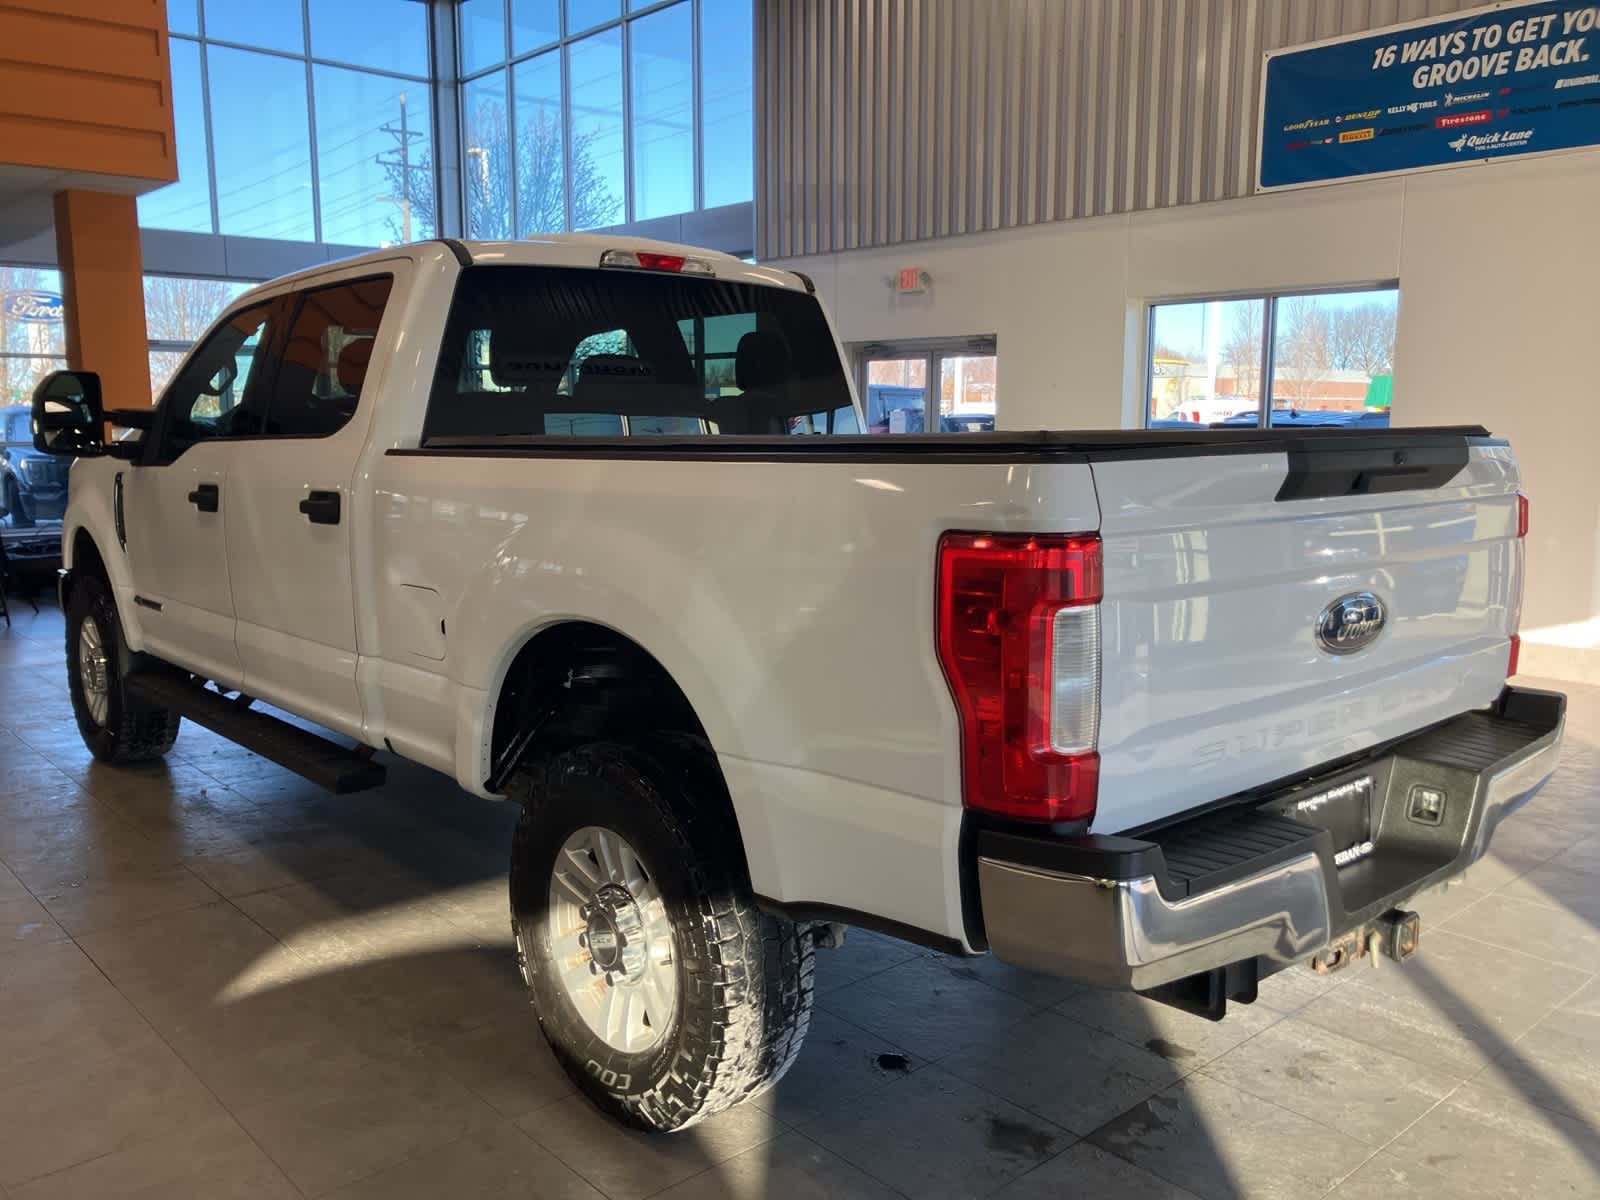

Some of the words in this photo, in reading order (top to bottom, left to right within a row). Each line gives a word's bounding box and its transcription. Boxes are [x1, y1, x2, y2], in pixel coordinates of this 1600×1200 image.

[1372, 45, 1398, 70] 16
[1400, 30, 1468, 64] WAYS
[1472, 24, 1502, 51] TO
[1506, 14, 1557, 44] GET
[1412, 51, 1512, 88] GROOVE
[1515, 38, 1590, 72] BACK.
[1344, 109, 1382, 121] DUNLOP
[1387, 104, 1407, 114] KELLY
[1440, 113, 1487, 127] Firestone
[1467, 132, 1502, 147] Quick
[1501, 129, 1533, 141] Lane
[12, 295, 64, 318] Ford
